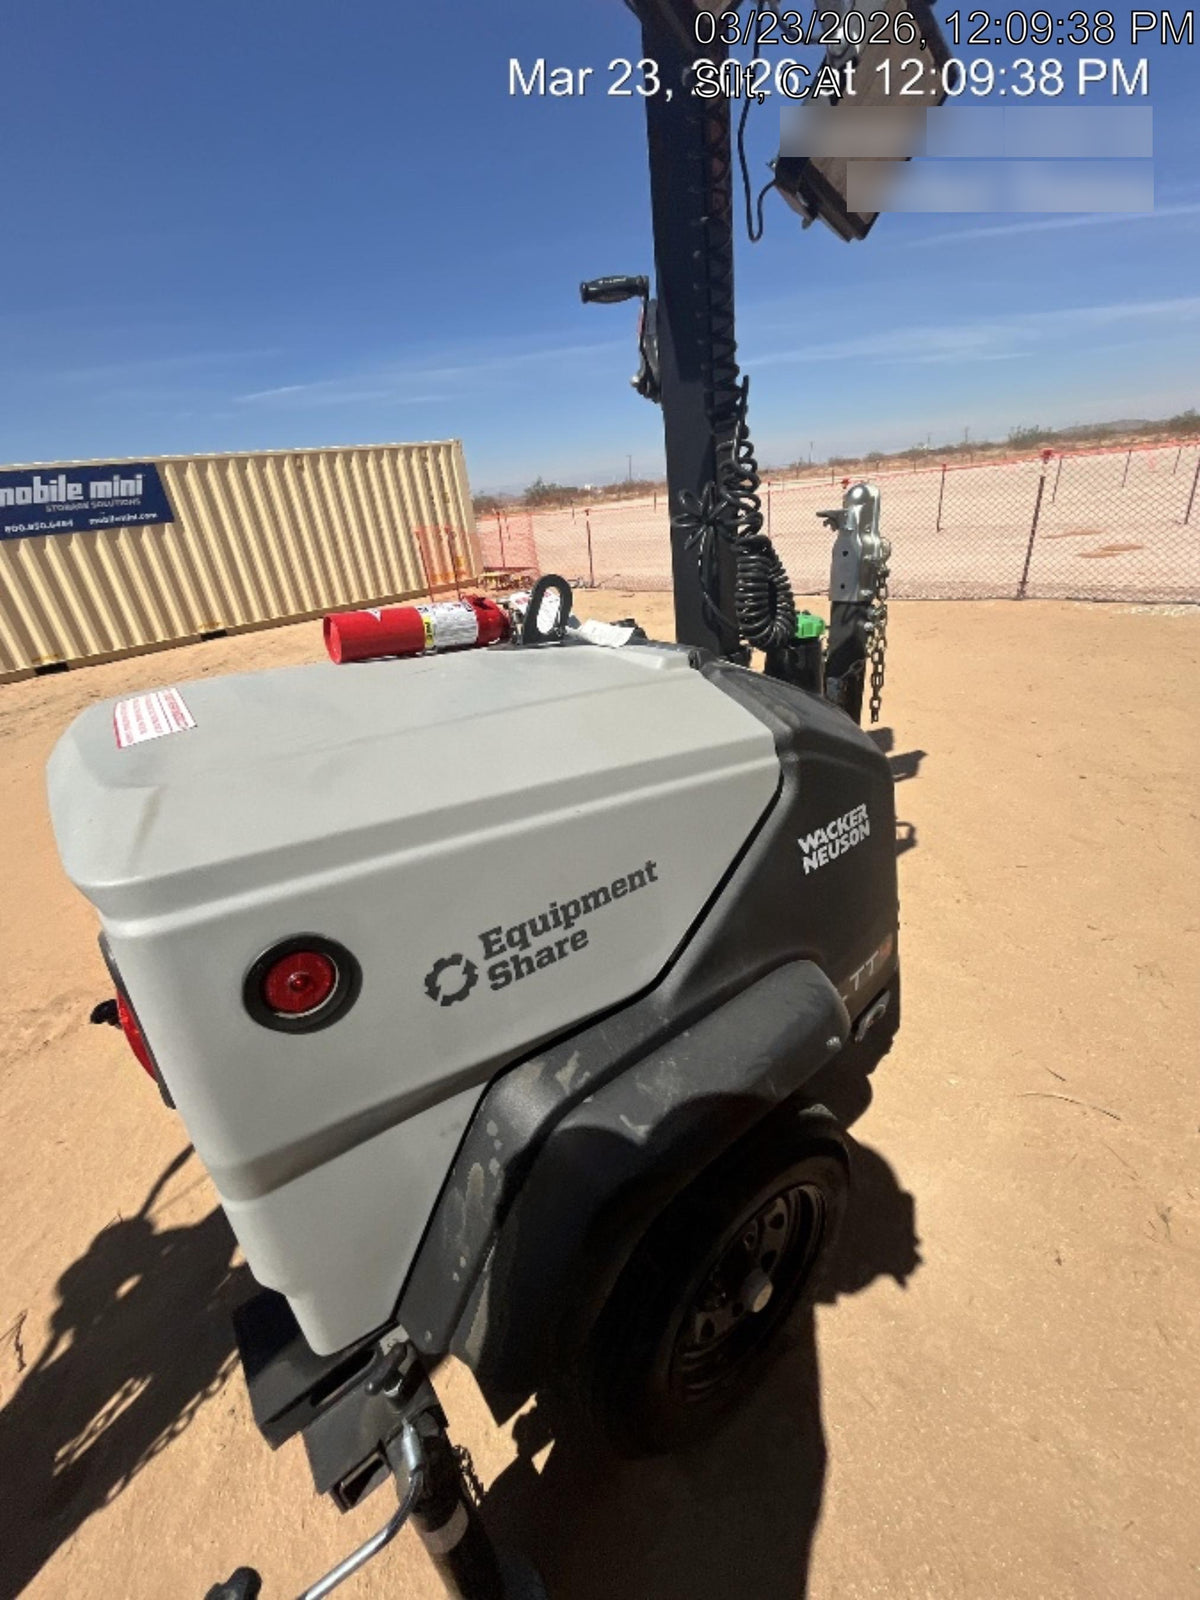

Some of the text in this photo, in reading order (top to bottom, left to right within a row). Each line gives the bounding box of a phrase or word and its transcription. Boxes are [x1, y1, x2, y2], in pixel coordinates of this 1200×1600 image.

[90, 474, 143, 499] mini
[798, 803, 869, 854] WACKER
[802, 820, 871, 876] NEUSON
[478, 860, 659, 960] Equipment
[487, 928, 590, 991] Share
